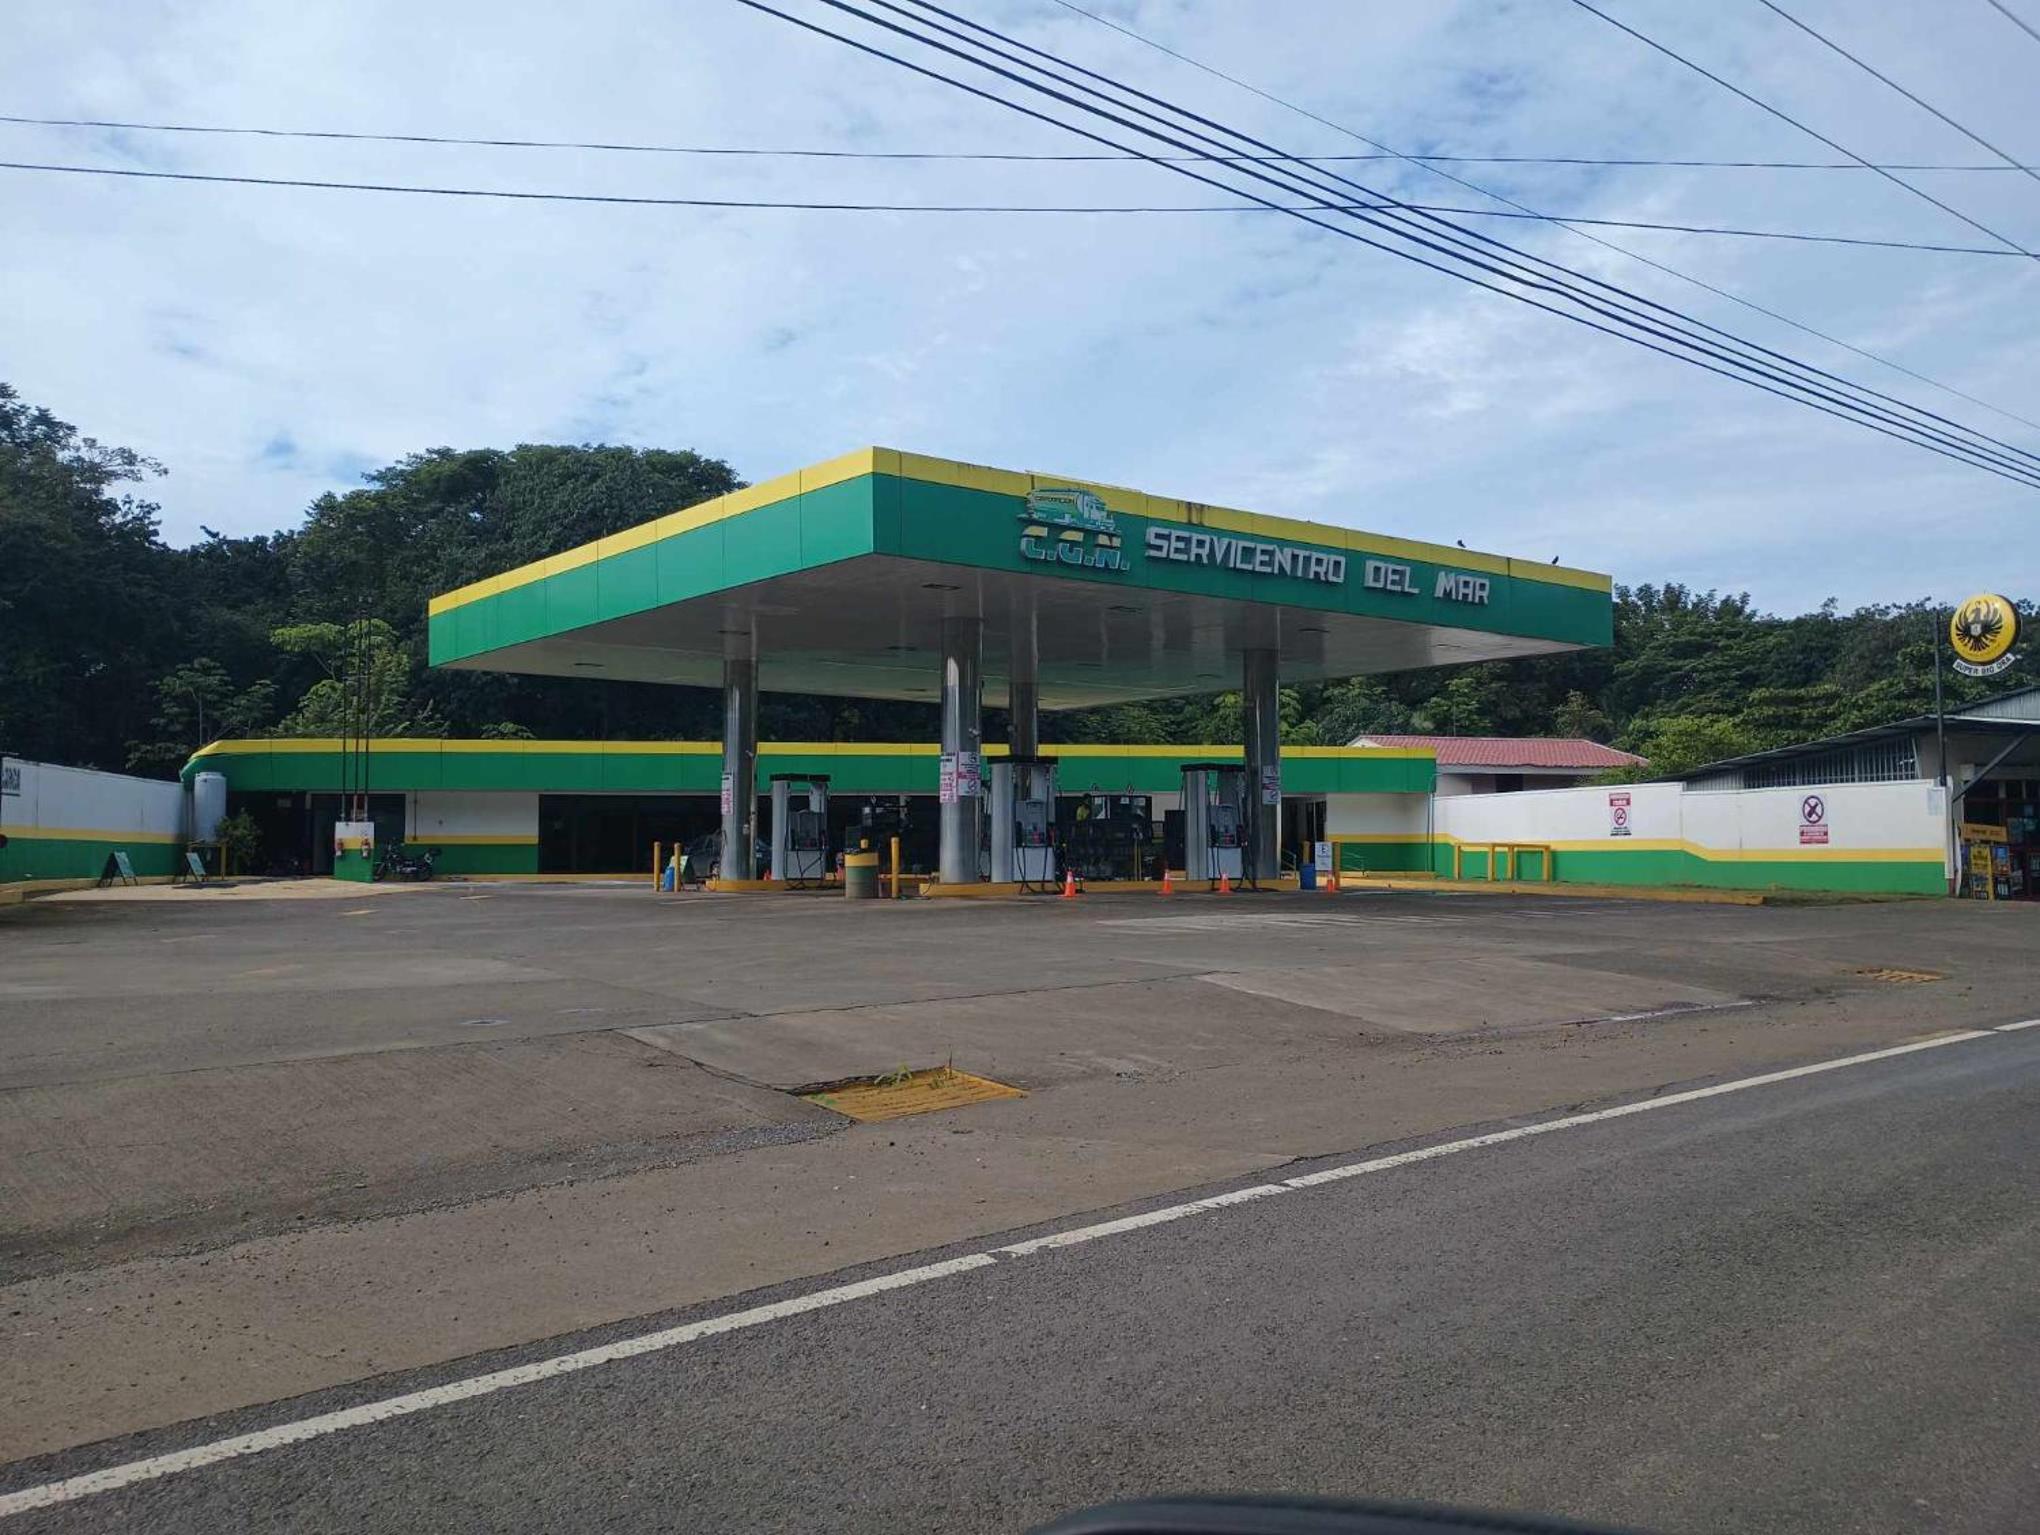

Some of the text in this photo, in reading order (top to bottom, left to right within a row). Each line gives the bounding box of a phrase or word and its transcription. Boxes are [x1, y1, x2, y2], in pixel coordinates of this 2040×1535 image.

[1145, 526, 1489, 605] SERVICENTRO DEL MAR
